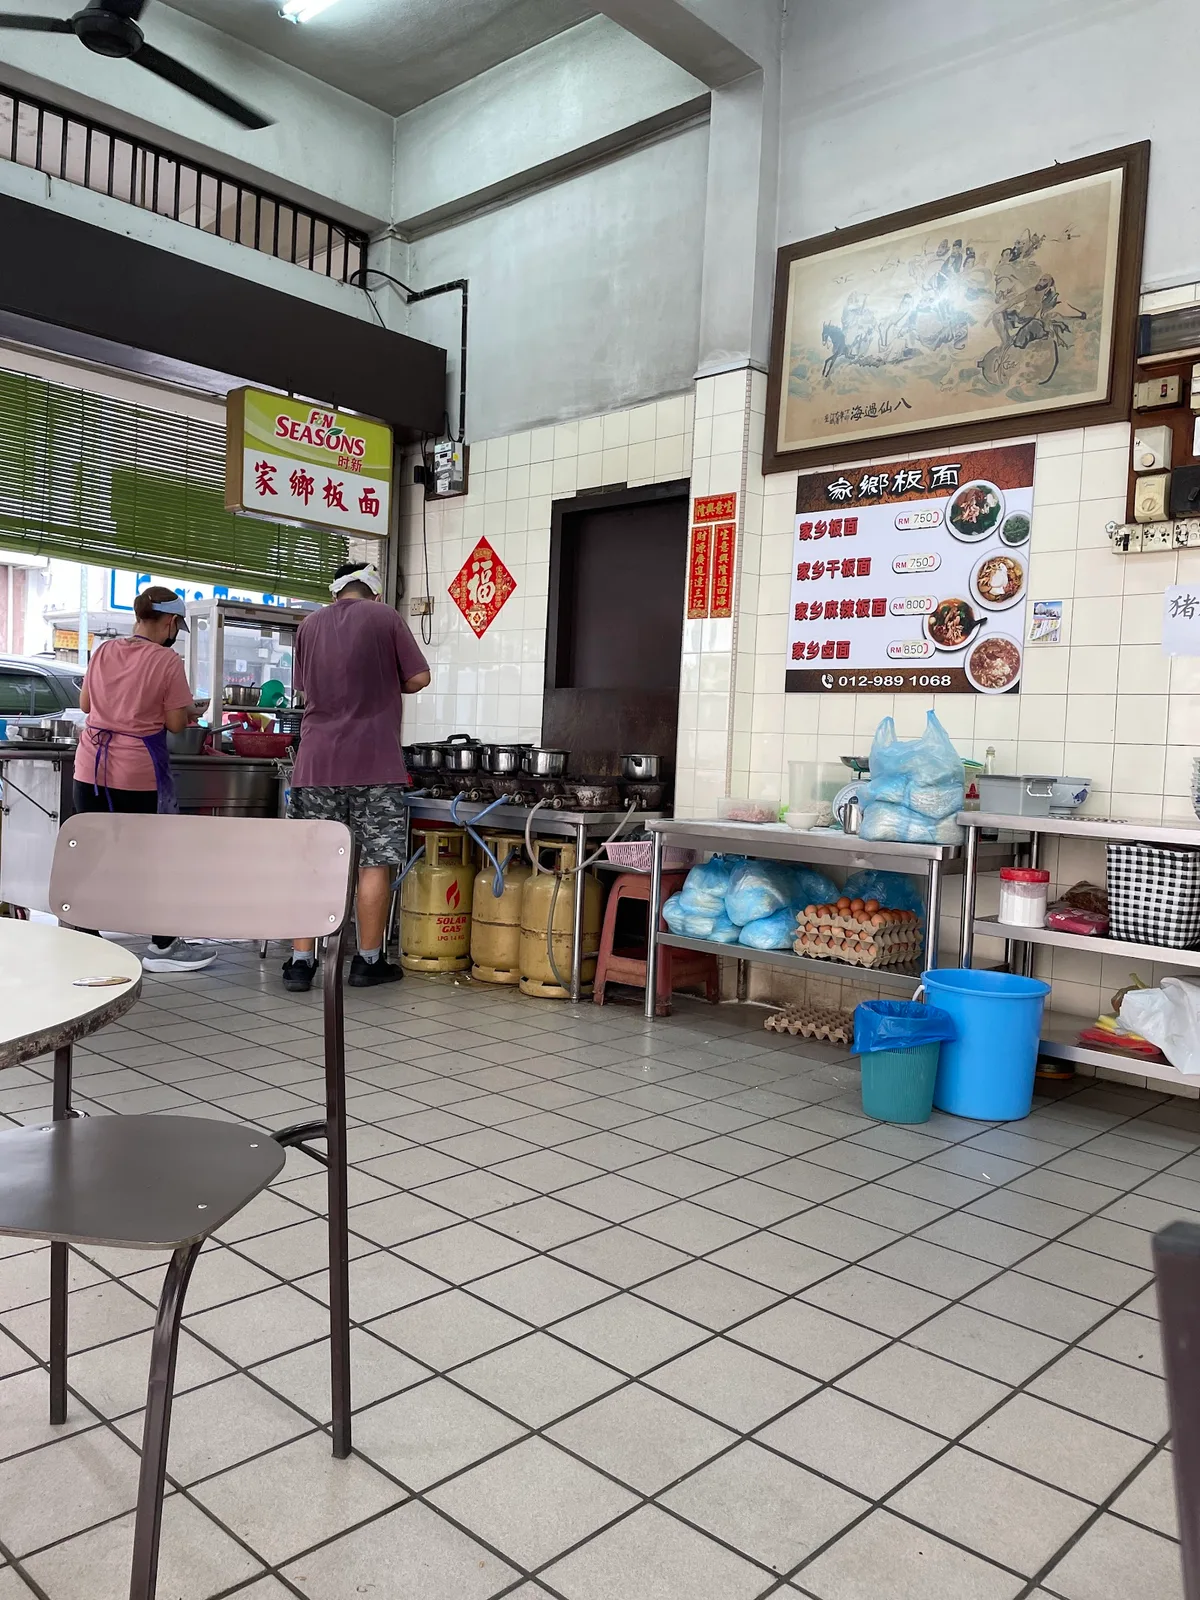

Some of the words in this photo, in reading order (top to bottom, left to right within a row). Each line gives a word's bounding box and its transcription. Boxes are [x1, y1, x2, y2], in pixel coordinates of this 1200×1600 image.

[275, 415, 365, 457] SEASONS
[337, 455, 363, 473] 时新
[254, 460, 380, 517] 家鄉板面
[827, 463, 962, 501] 家鄉板面
[798, 516, 859, 541] 家乡板面
[898, 517, 910, 525] RM
[796, 556, 872, 581] 家乡干板面
[895, 561, 907, 569] RM
[467, 560, 496, 604] 福
[794, 598, 887, 621] 家乡麻辣板面
[892, 602, 905, 610] RM
[1168, 593, 1200, 620] 猪
[791, 640, 851, 661] 家乡卤面
[838, 675, 904, 687] 012-989
[909, 675, 952, 687] 1068
[436, 916, 467, 925] SOLAR
[441, 925, 462, 933] GAS
